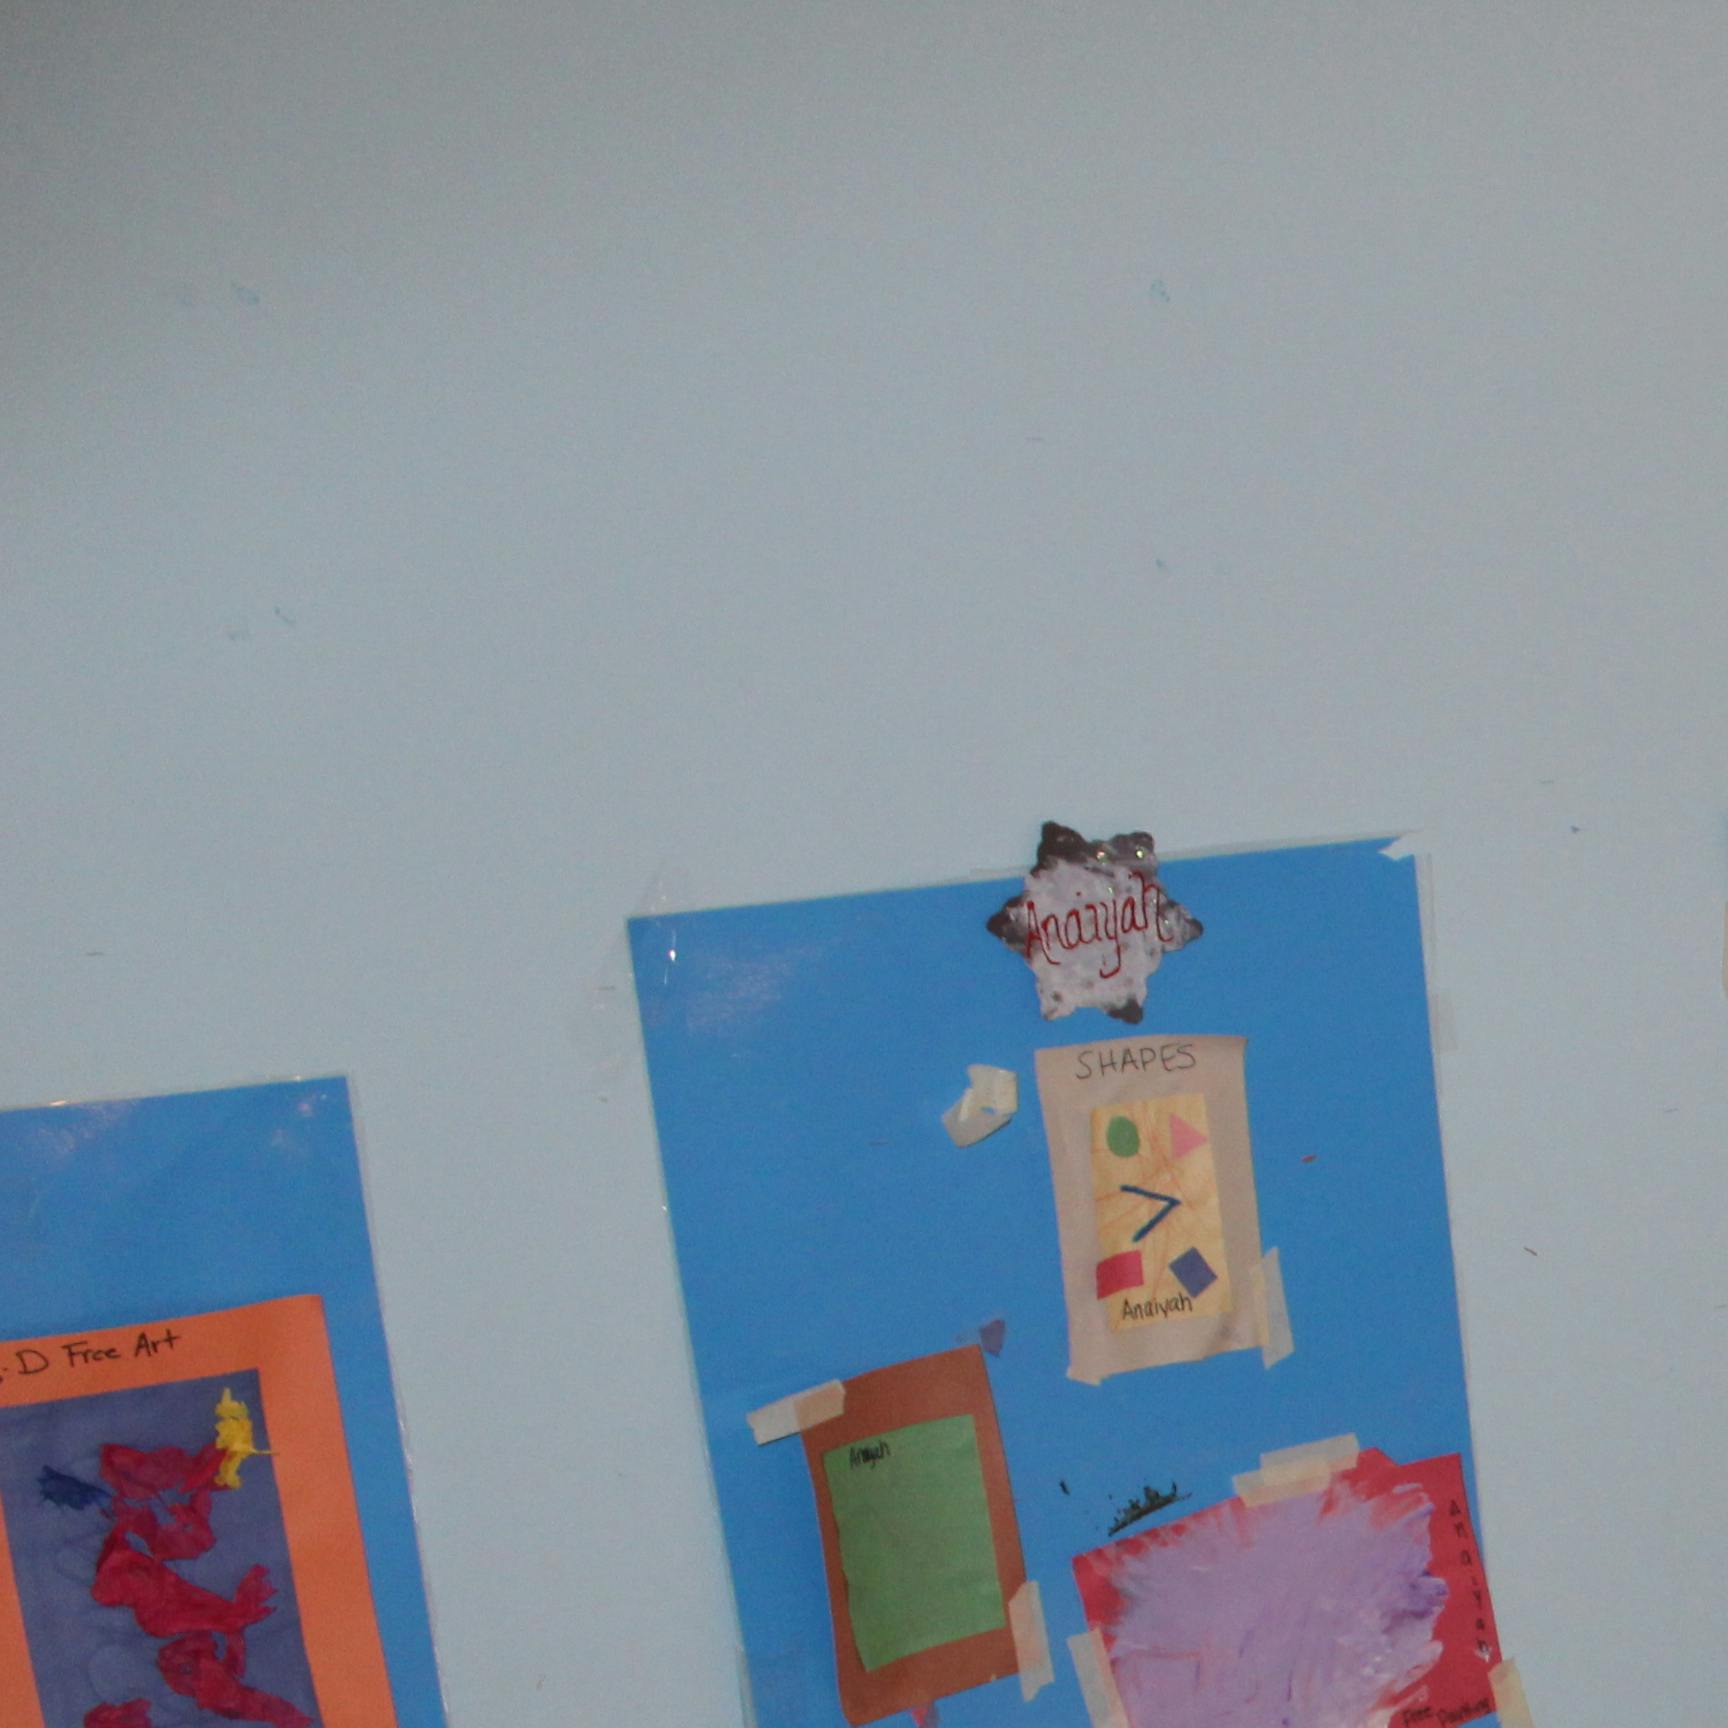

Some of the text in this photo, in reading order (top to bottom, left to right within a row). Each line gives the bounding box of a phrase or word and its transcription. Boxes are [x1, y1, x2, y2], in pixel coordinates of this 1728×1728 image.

[1026, 870, 1174, 978] Anaiyah
[1076, 1043, 1197, 1080] SHAPES
[1121, 1291, 1193, 1321] Anaiyah
[61, 1340, 122, 1368] Free
[133, 1329, 181, 1358] Art
